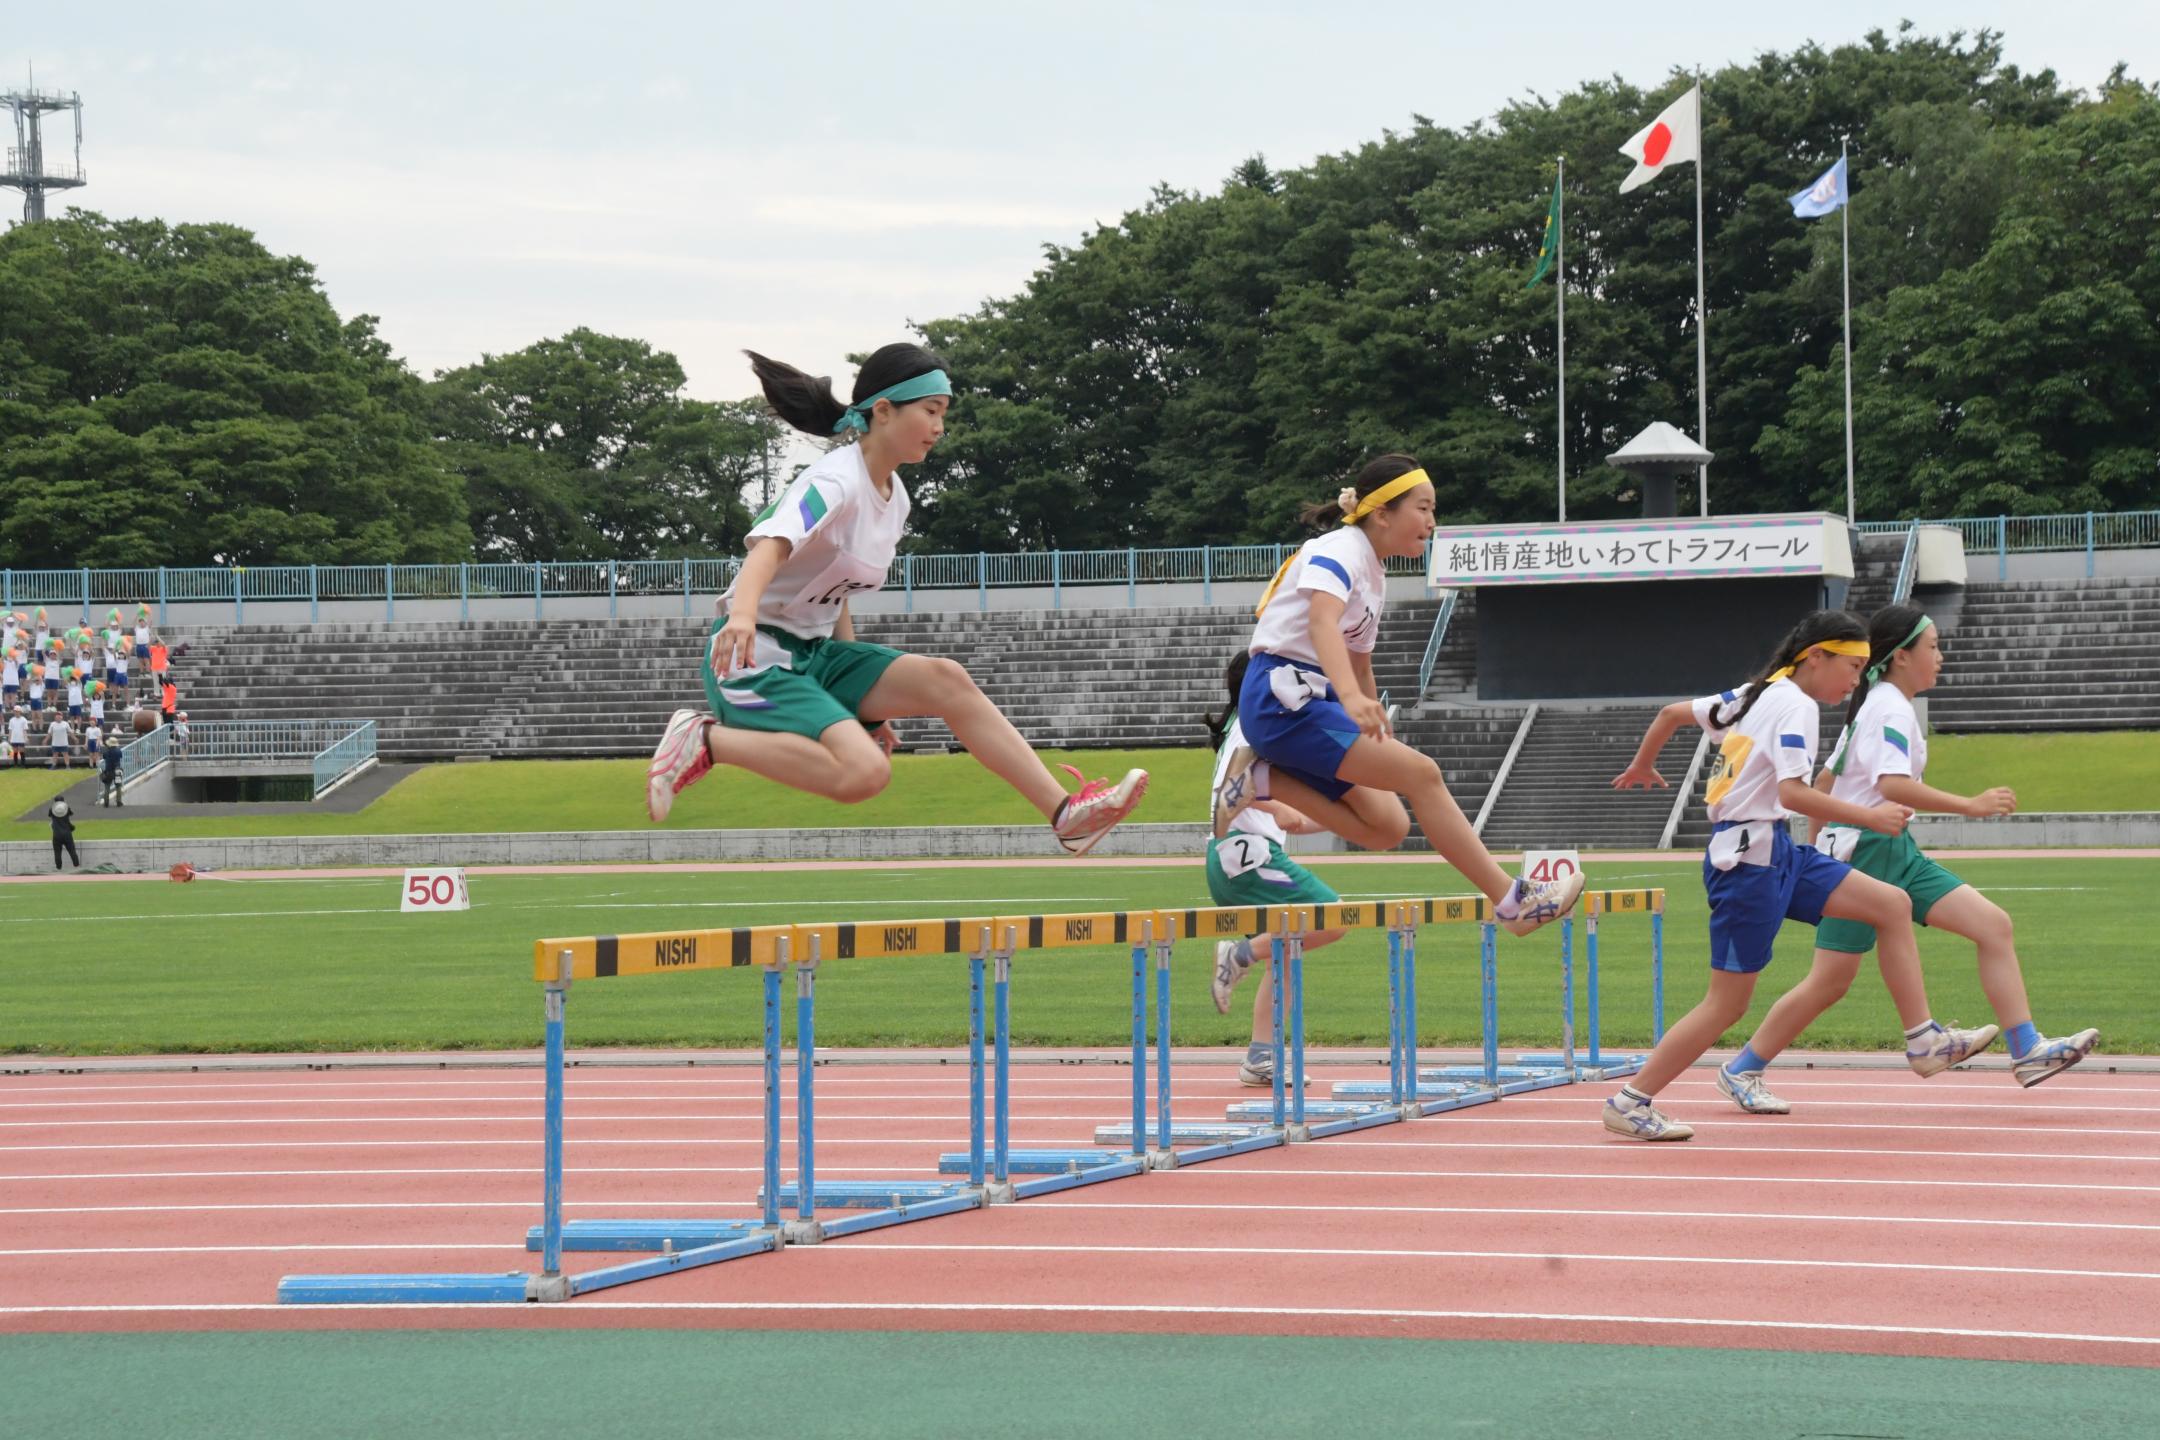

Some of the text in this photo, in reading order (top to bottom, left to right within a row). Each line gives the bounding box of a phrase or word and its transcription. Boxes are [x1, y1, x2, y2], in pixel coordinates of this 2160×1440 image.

[1449, 537, 1809, 572] 純情産地いわてトラフィール
[1235, 839, 1254, 868] 2
[1529, 858, 1575, 883] 40
[408, 875, 455, 905] 50
[1215, 912, 1238, 933] NISHI
[1340, 907, 1361, 926] NISHI
[1446, 902, 1463, 919] NISHI
[883, 927, 917, 952] NISHI
[1065, 919, 1092, 941] NISHI
[655, 937, 697, 967] NISHI
